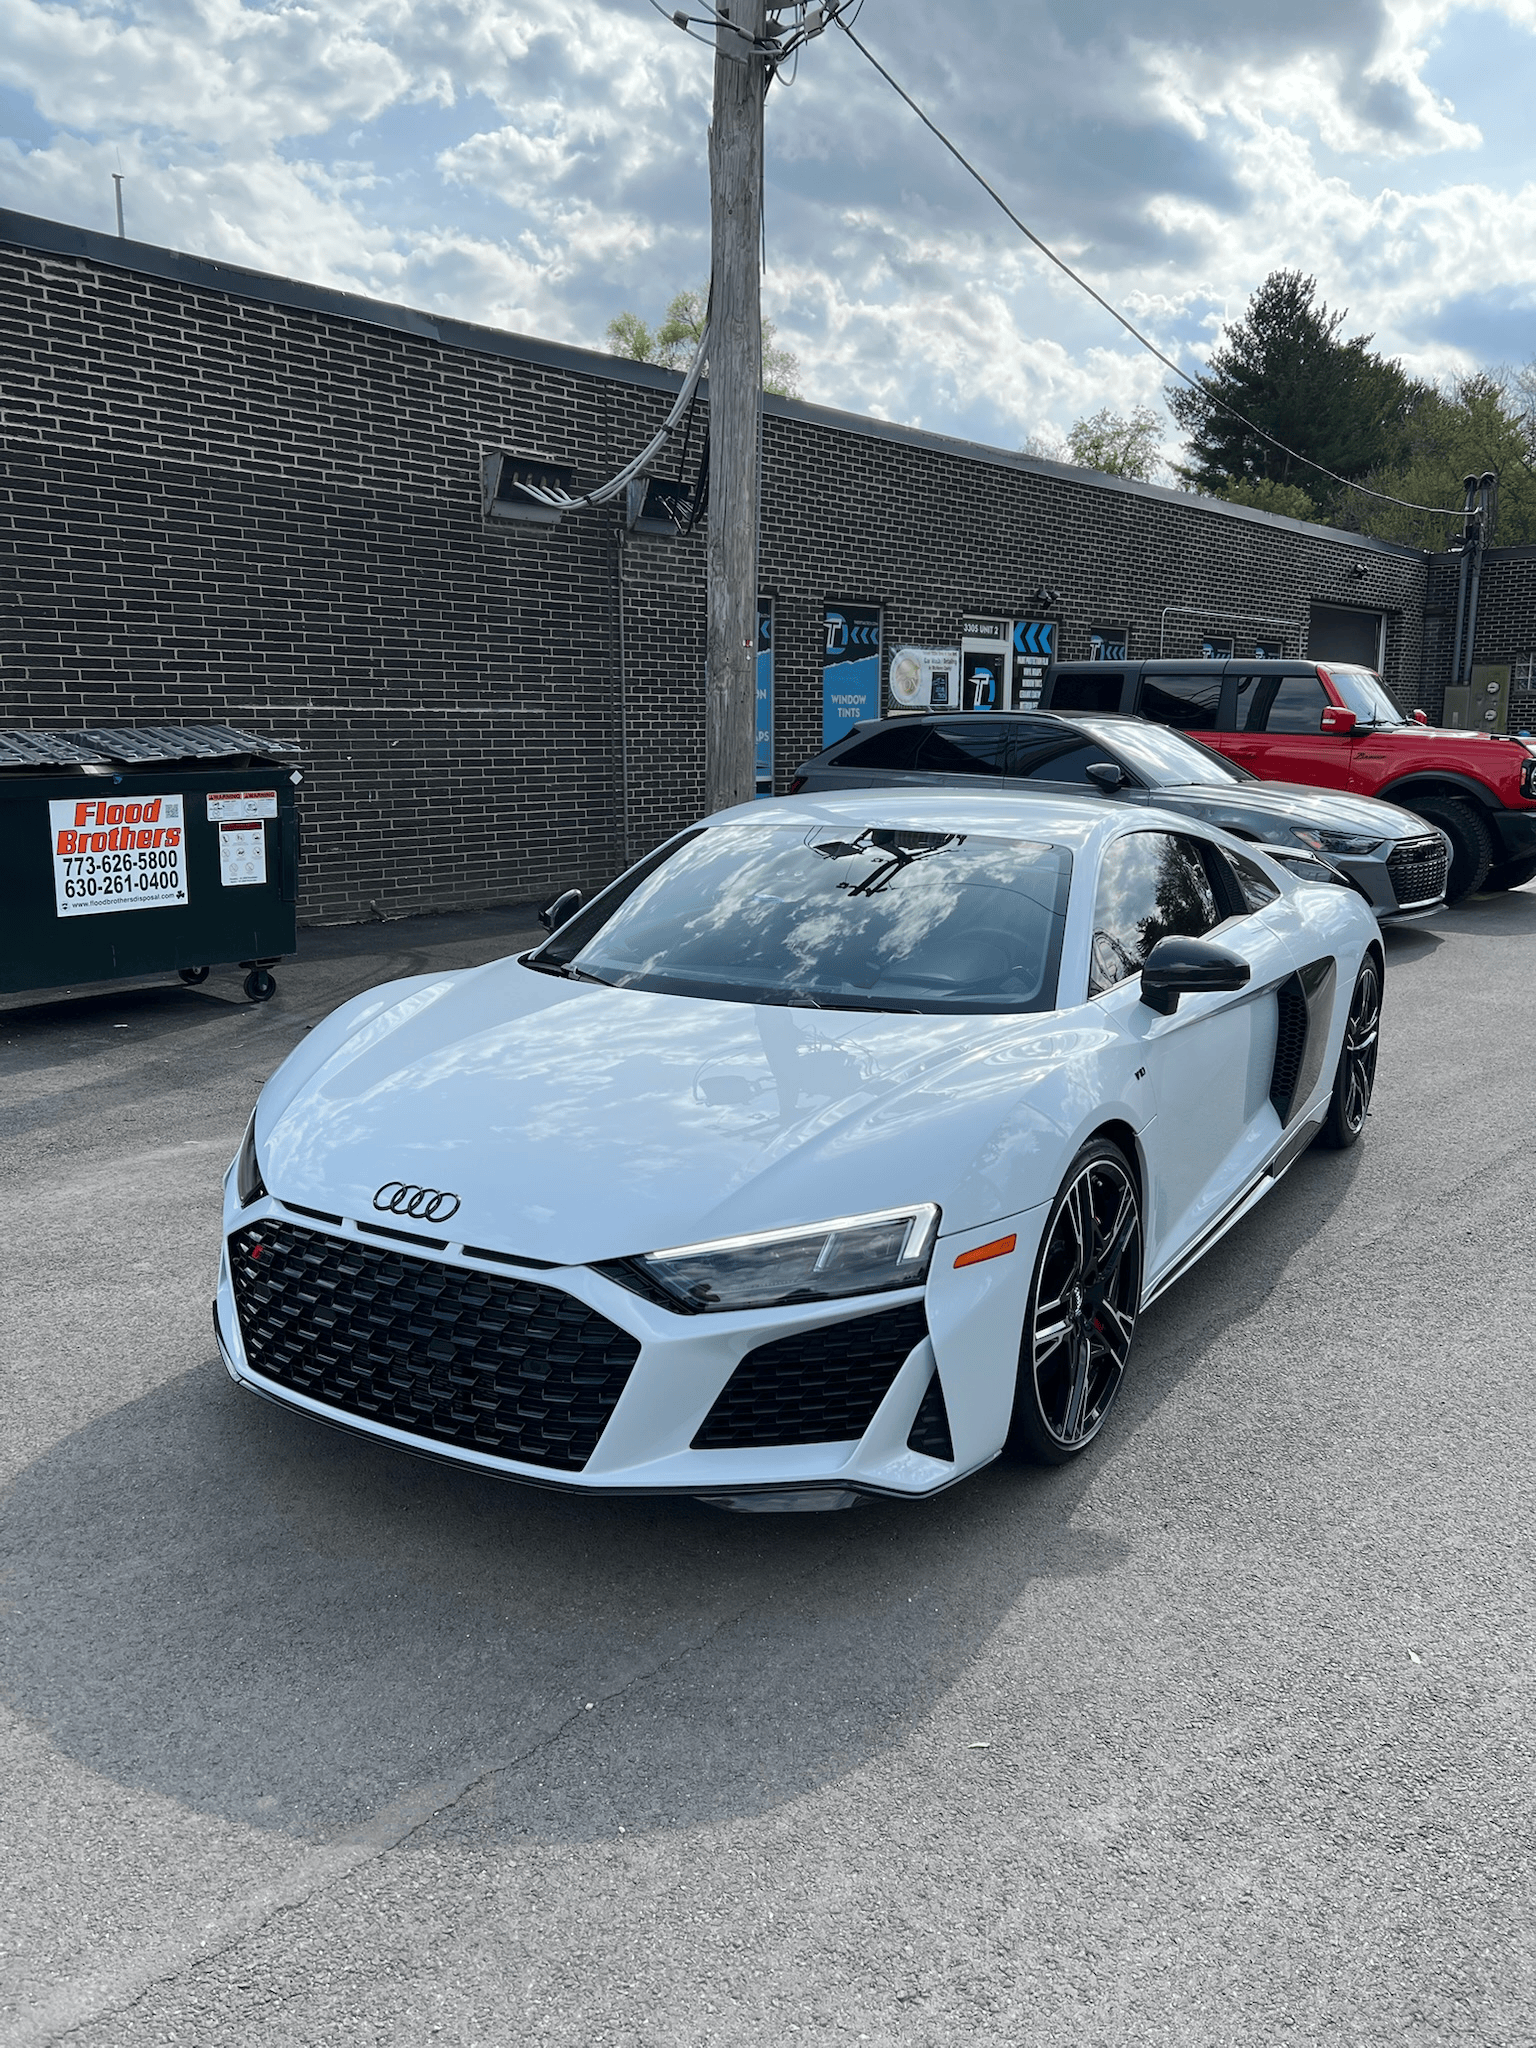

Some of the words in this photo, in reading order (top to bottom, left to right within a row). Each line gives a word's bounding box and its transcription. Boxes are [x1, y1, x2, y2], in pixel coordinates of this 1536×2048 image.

[963, 623, 979, 633] 3305
[980, 625, 993, 634] UNIT
[994, 626, 999, 635] 2
[831, 694, 866, 705] WINDOW
[837, 708, 860, 718] TINTS
[74, 798, 162, 827] Flood
[56, 826, 182, 855] Brothers
[63, 850, 177, 876] 773-626-5800
[65, 870, 179, 898] 630-261-0400
[72, 893, 175, 909] www.floodbrothersdisposal.com
